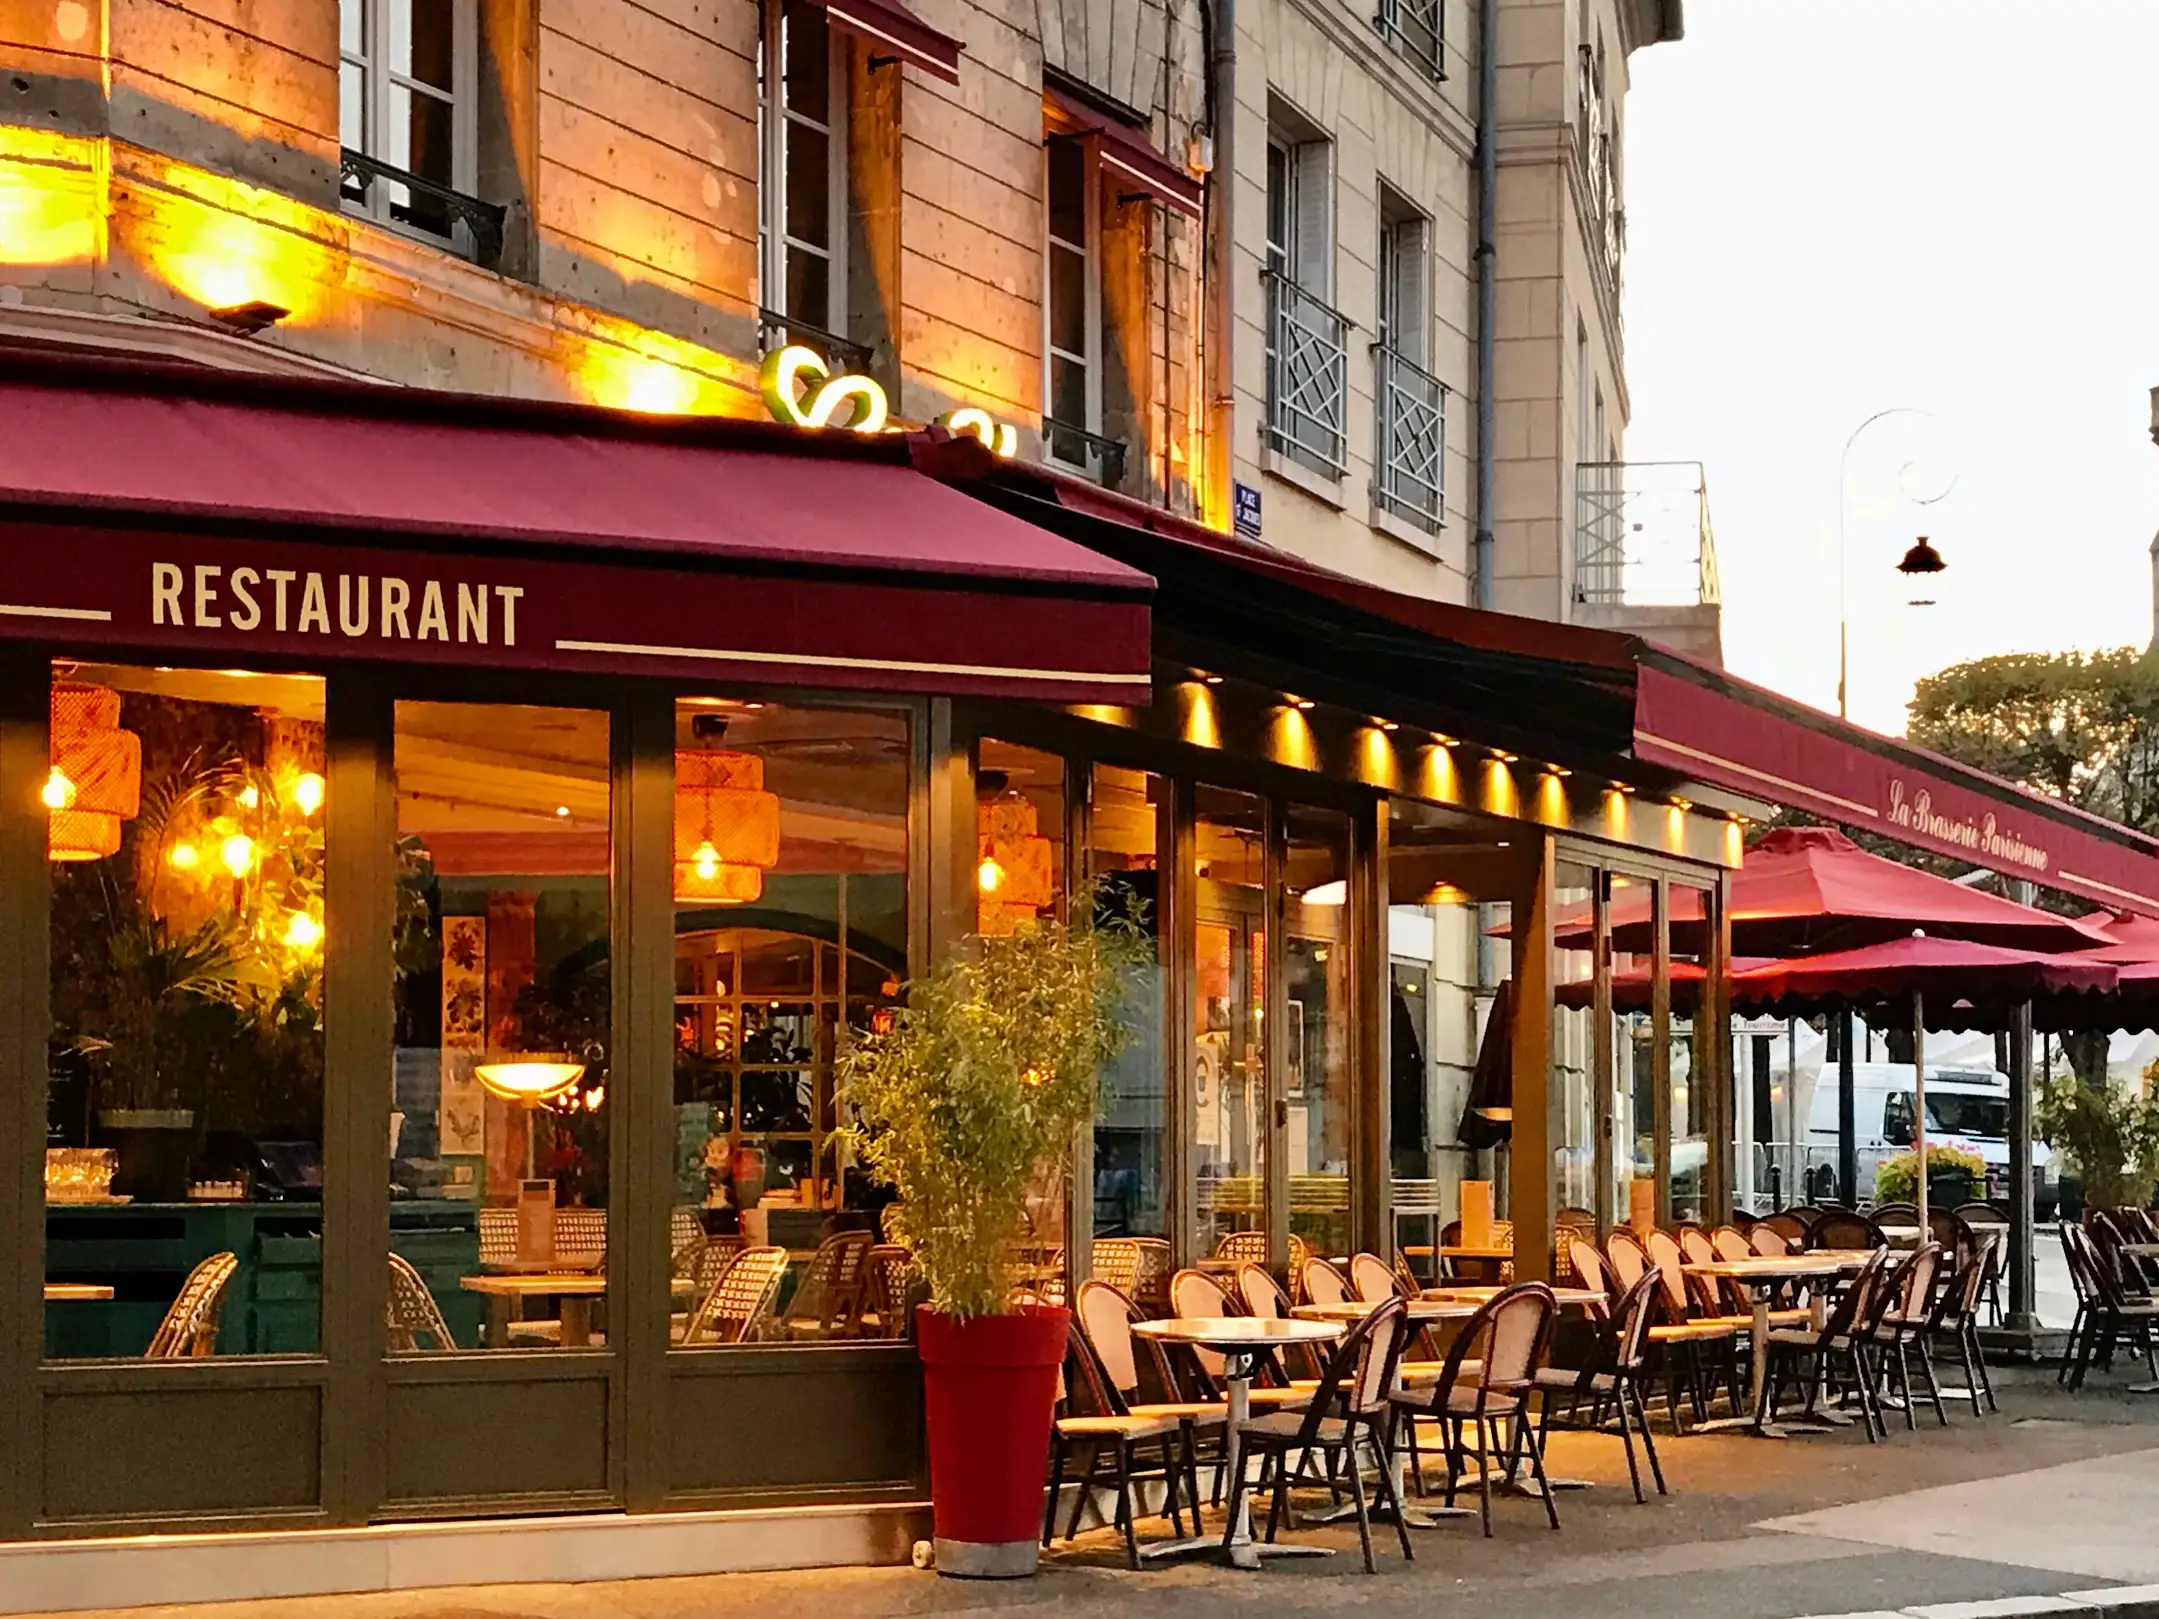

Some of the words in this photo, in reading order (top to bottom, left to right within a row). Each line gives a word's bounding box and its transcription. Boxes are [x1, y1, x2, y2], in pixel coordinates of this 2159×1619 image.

[152, 562, 524, 646] RESTAURANT
[1886, 779, 1911, 828] La
[1912, 788, 1979, 849] Brasserie
[1981, 811, 2049, 872] Parisienne
